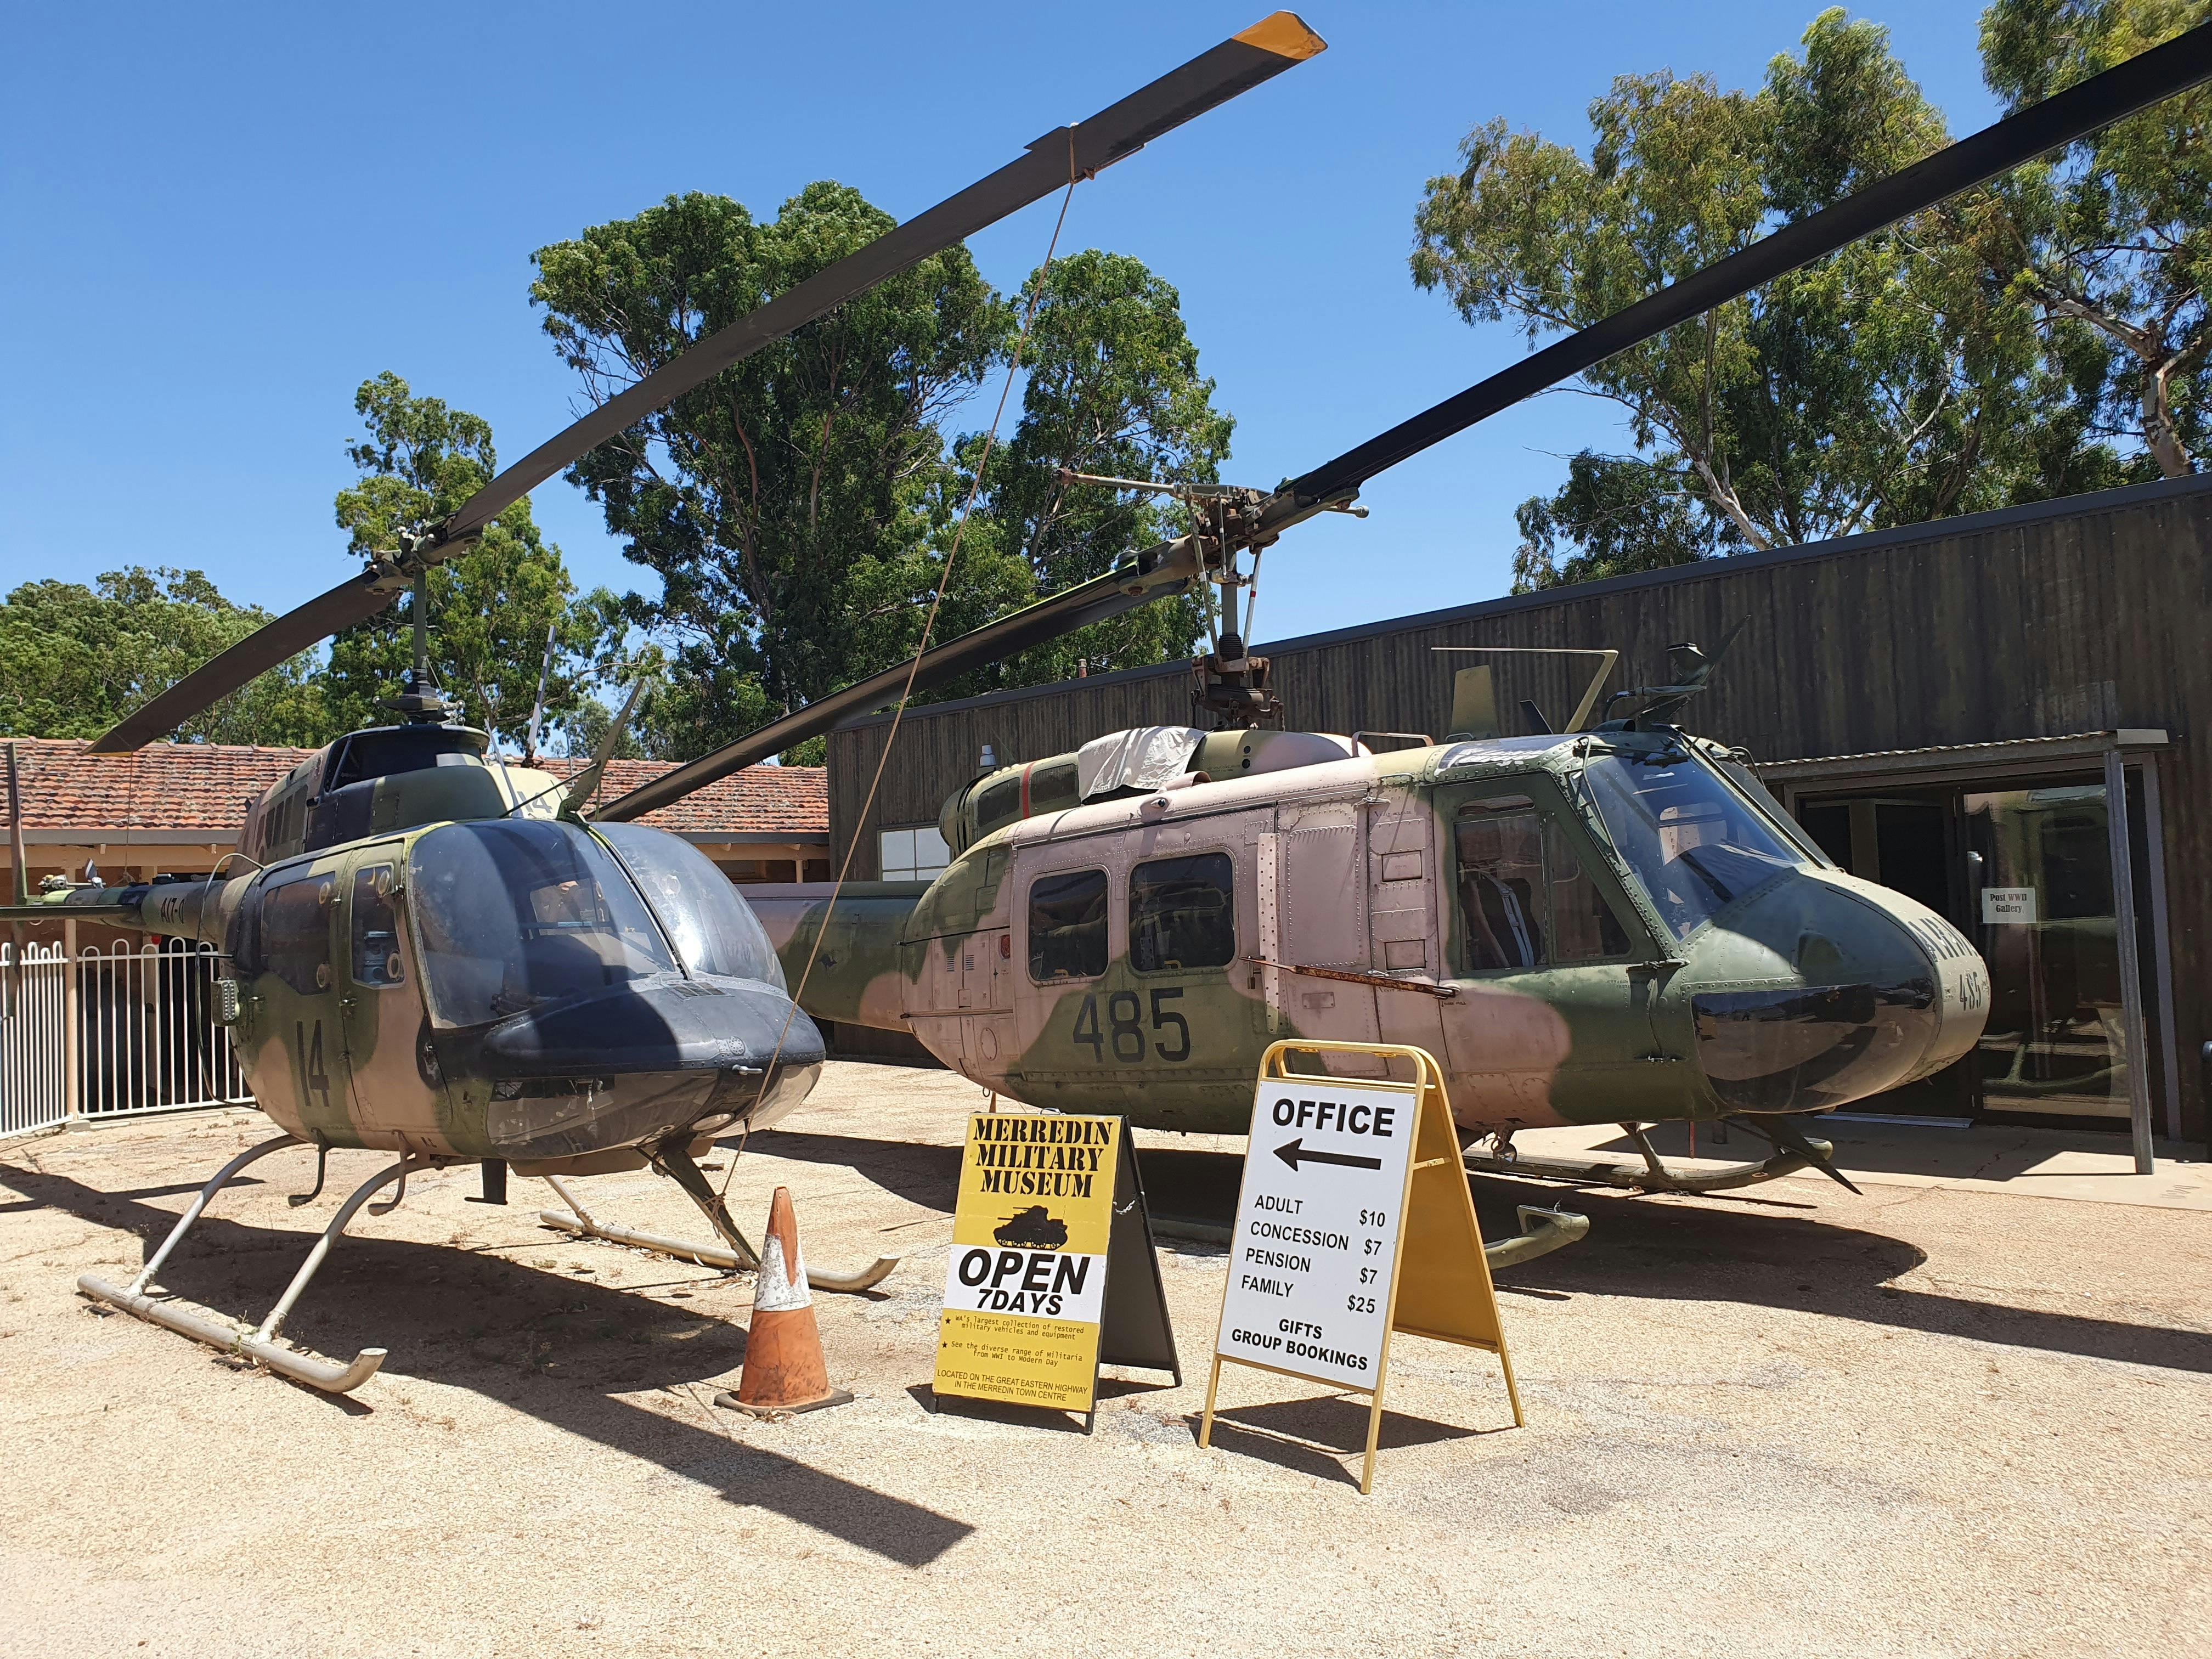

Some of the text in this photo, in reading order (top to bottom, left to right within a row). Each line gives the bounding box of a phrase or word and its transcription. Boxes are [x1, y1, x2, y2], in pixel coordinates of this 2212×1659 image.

[517, 791, 552, 813] 14
[1996, 905, 2022, 913] Gallery
[1960, 972, 1981, 1011] 485
[1073, 987, 1190, 1063] 485
[297, 1019, 330, 1107] 14
[1272, 1098, 1395, 1137] OFFICE
[973, 1119, 1113, 1145] MERREDIN
[975, 1143, 1104, 1171] MILITARY
[980, 1170, 1093, 1198] MUSEUM
[1254, 1195, 1385, 1227] ADULT $10
[1250, 1221, 1382, 1256] CONCESSION $7
[958, 1249, 1091, 1295] OPEN
[1246, 1248, 1378, 1285] PENSION $7
[1242, 1274, 1375, 1314] FAMILY $25
[962, 1323, 991, 1332] military
[994, 1325, 1024, 1334] vehicles
[1042, 1331, 1076, 1340] equipment
[974, 1316, 999, 1325] largest
[1002, 1320, 1039, 1329] collection
[1054, 1325, 1084, 1334] restored
[1279, 1318, 1323, 1339] GIFTS
[981, 1344, 1008, 1353] diverse
[1047, 1351, 1082, 1362] Militaria
[1019, 1355, 1043, 1364] Modern
[1046, 1358, 1058, 1367] Day
[1232, 1329, 1368, 1370] GROUP BOOKINGS
[937, 1369, 1088, 1395] LOCATED ON THE GREAT EASTERN HIGHWAY
[963, 1381, 976, 1390] THE
[978, 1383, 1014, 1395] MERREDIN
[1015, 1387, 1037, 1397] TOWN
[1038, 1390, 1068, 1401] CENTRE
